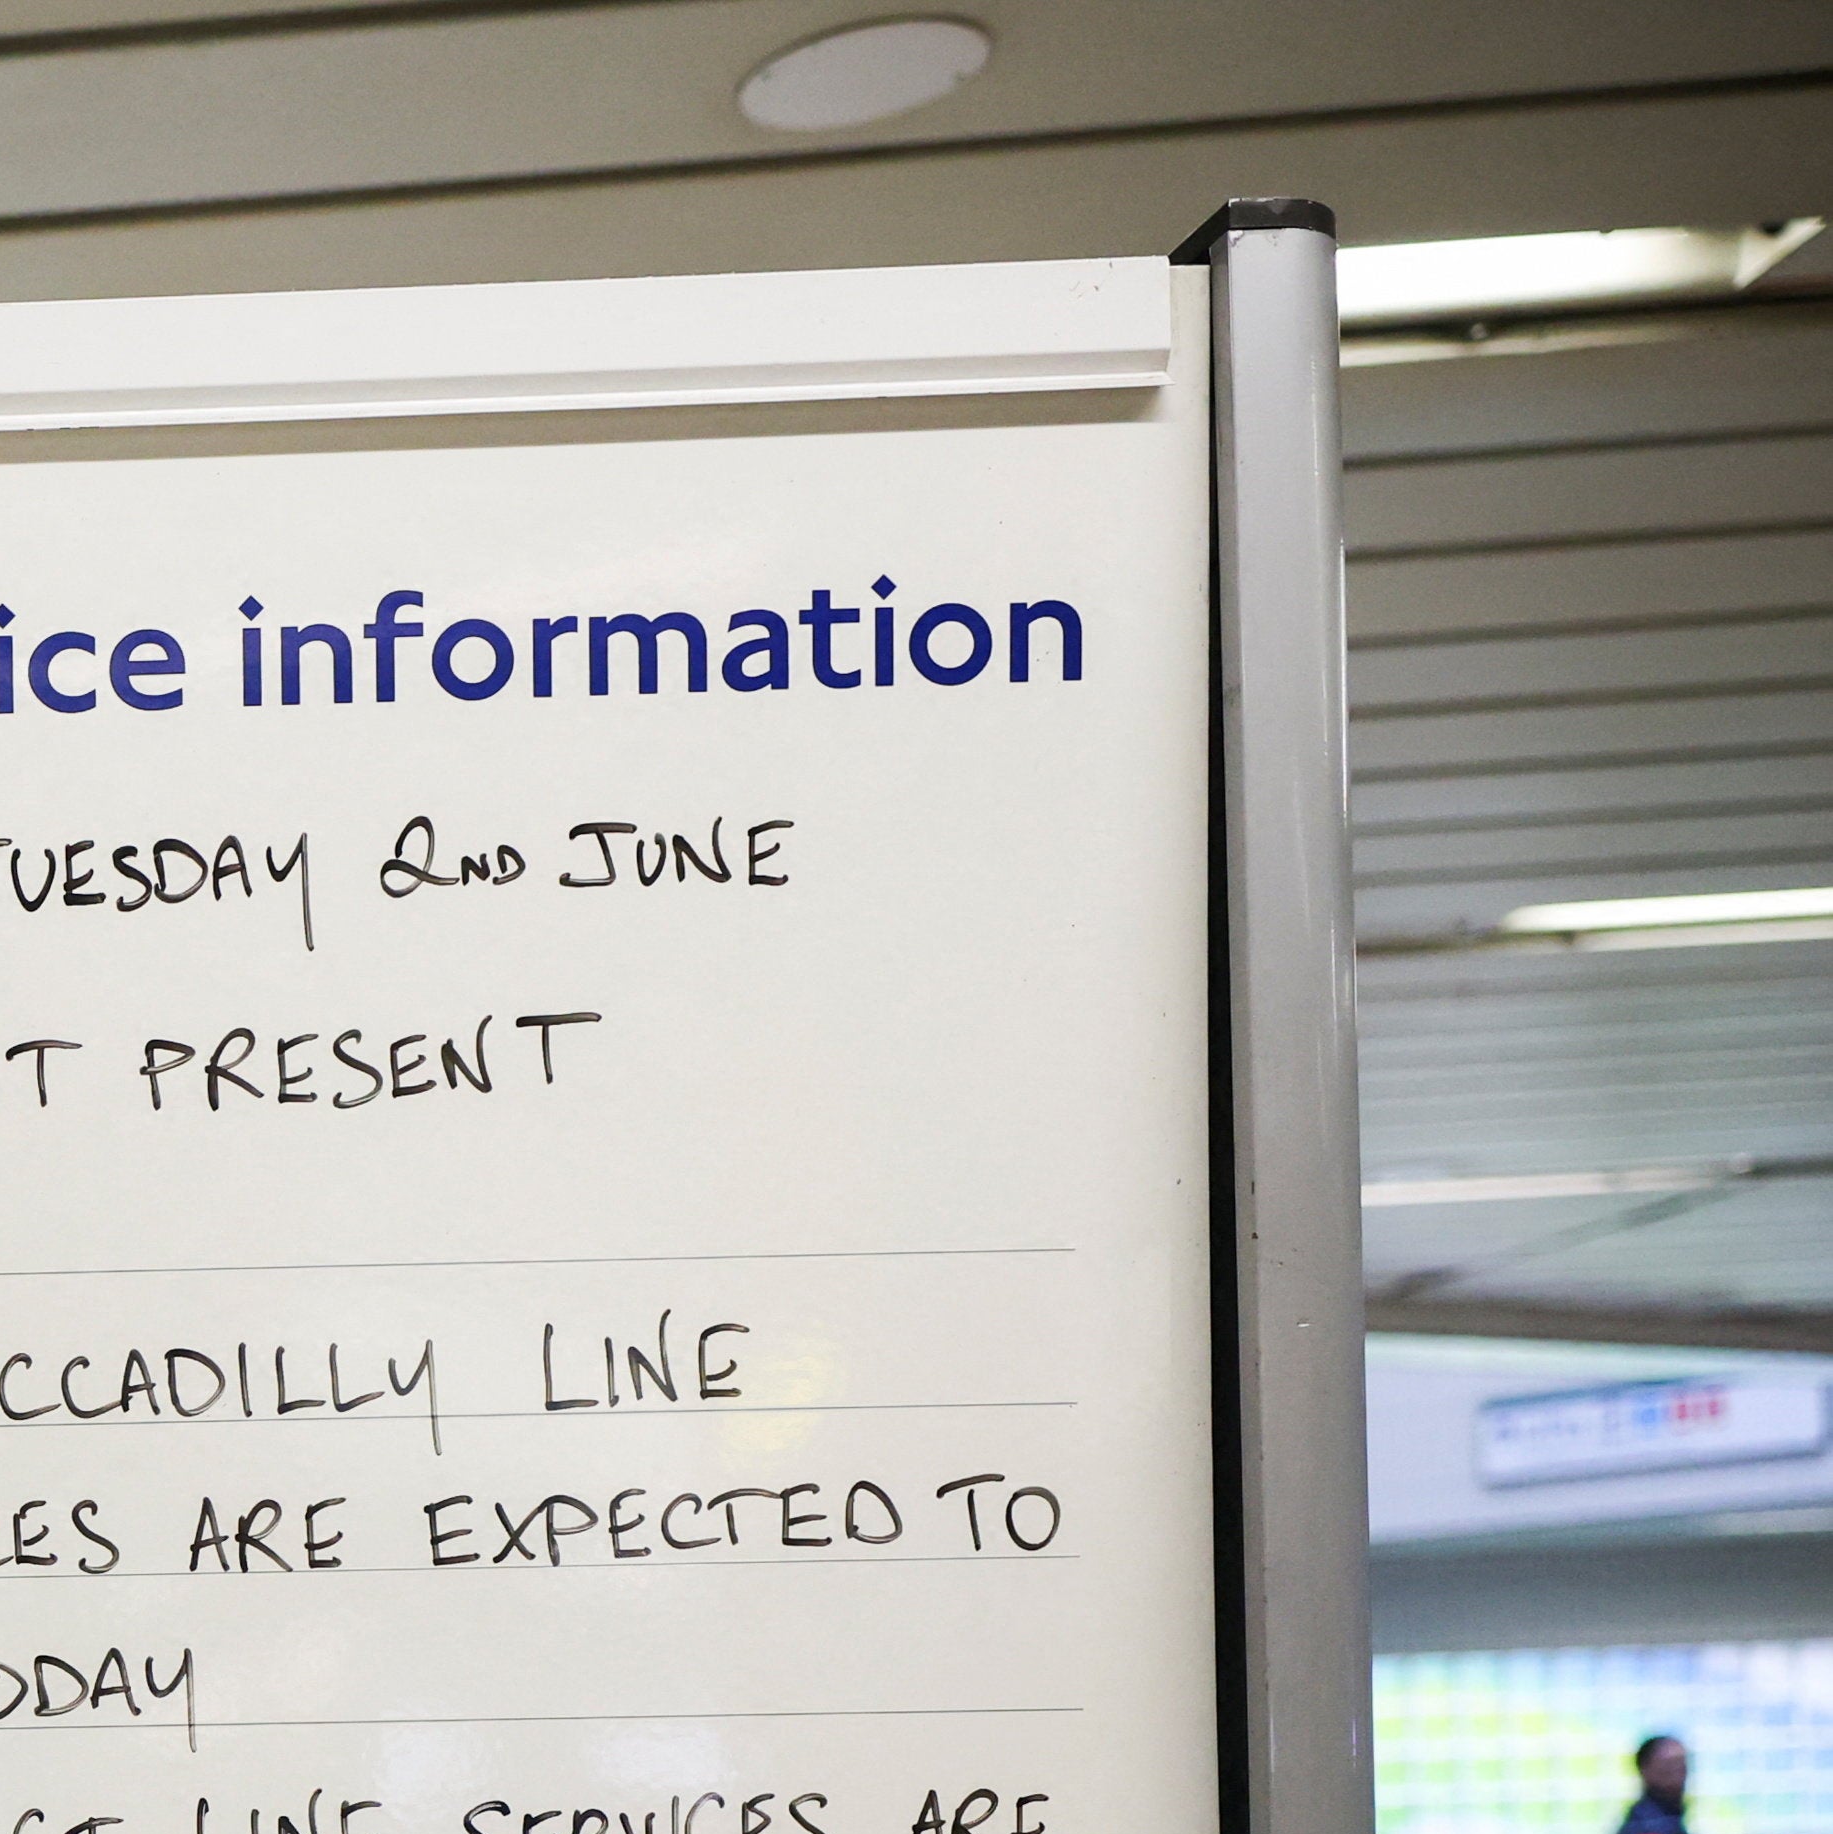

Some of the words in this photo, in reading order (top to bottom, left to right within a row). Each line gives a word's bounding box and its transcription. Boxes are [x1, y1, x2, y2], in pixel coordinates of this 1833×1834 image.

[236, 572, 1084, 708] information
[378, 814, 528, 900] 2ND
[557, 814, 796, 890] JUNE
[138, 1010, 604, 1113] PRESENT
[541, 1307, 752, 1413] LINE
[187, 1495, 348, 1575] ARE
[422, 1479, 904, 1569] EXPECTED
[934, 1472, 1062, 1553] TO
